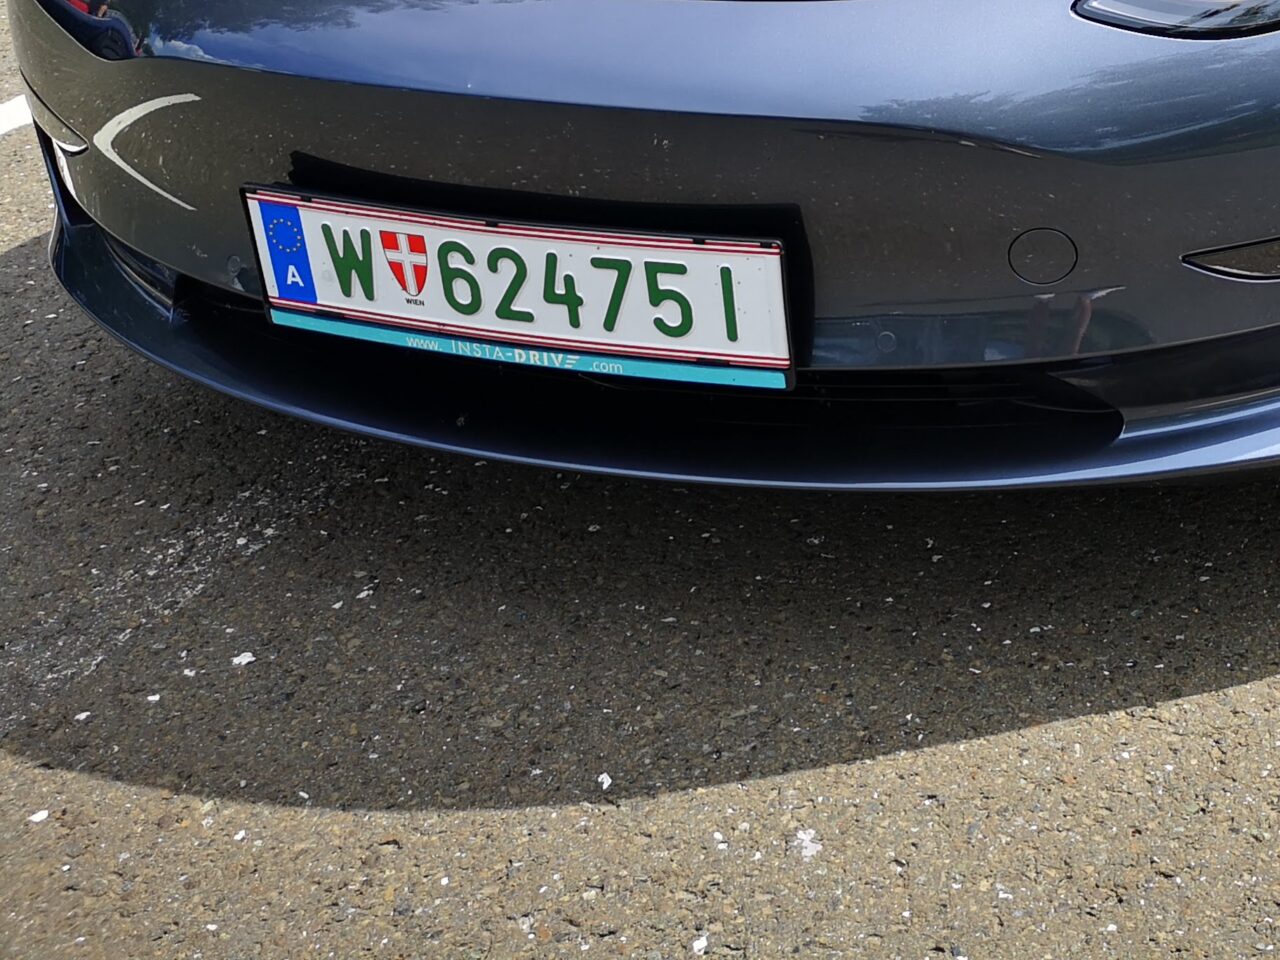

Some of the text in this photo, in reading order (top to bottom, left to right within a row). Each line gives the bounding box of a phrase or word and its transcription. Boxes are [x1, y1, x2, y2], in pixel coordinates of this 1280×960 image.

[320, 222, 375, 301] W
[286, 264, 305, 287] A
[405, 297, 425, 306] WIEN
